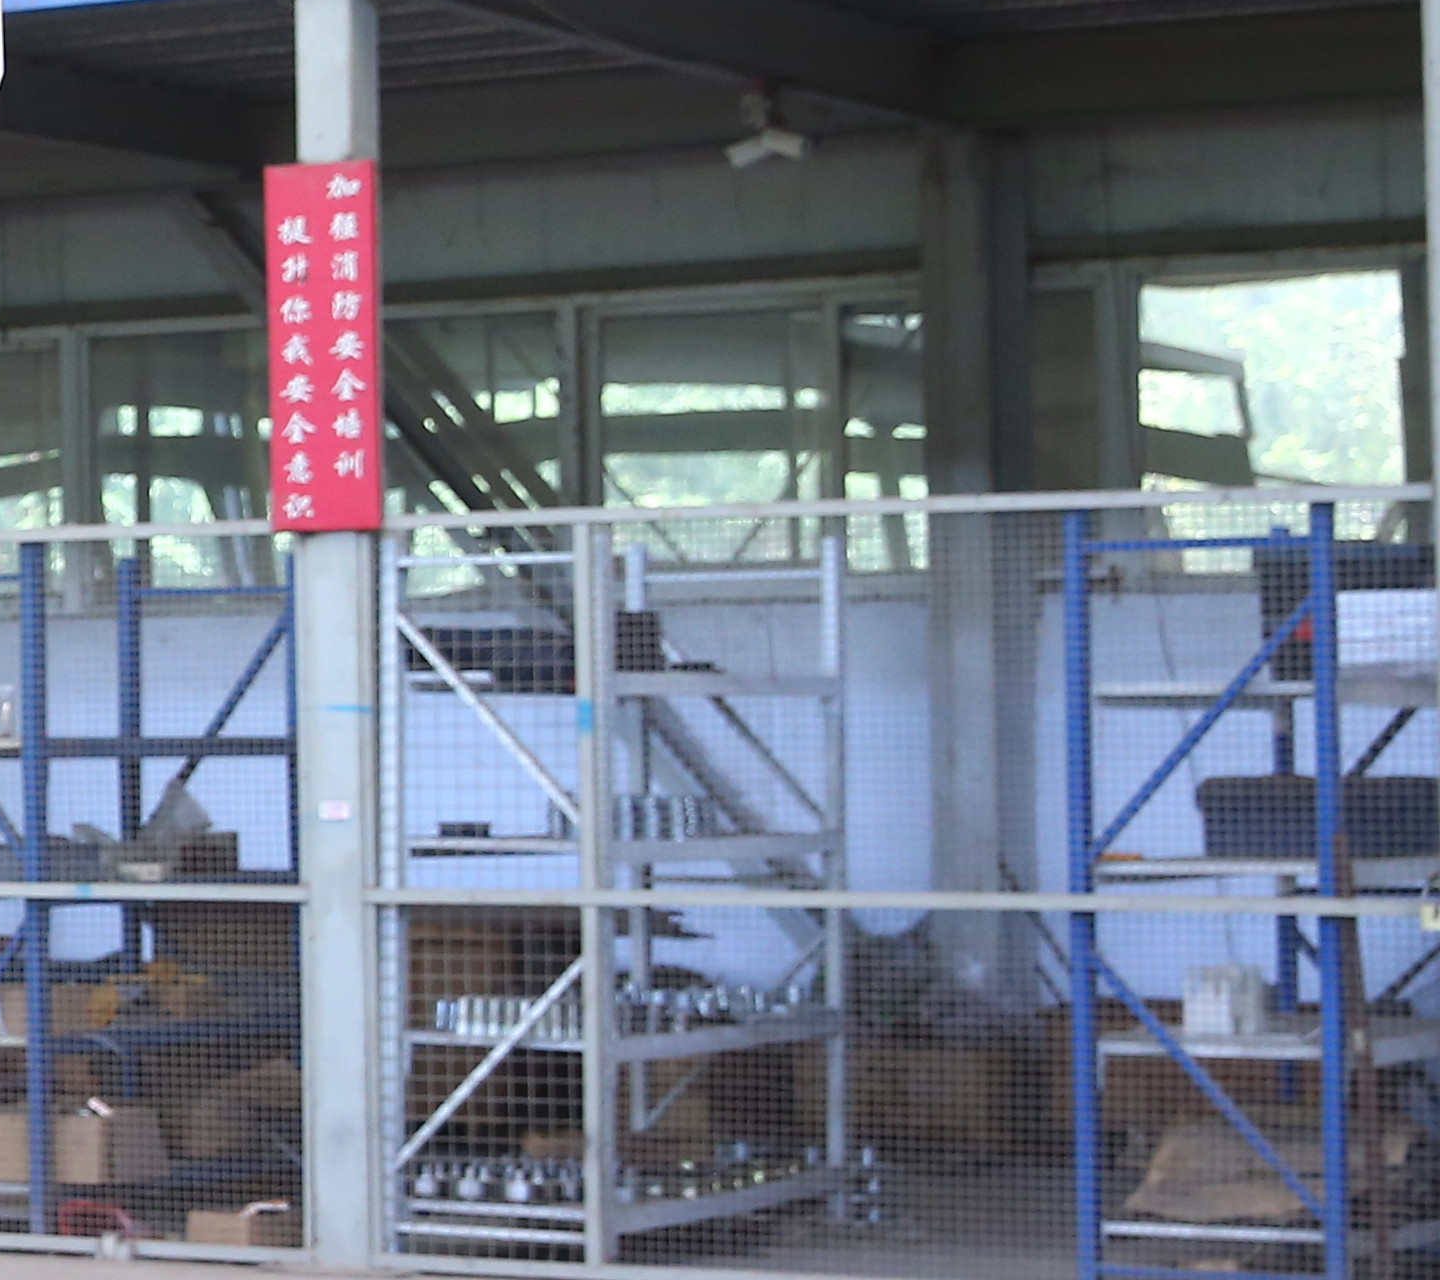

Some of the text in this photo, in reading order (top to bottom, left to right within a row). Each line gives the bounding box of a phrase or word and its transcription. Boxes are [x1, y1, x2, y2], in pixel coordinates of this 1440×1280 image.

[277, 215, 317, 520] 提升你我安全意识
